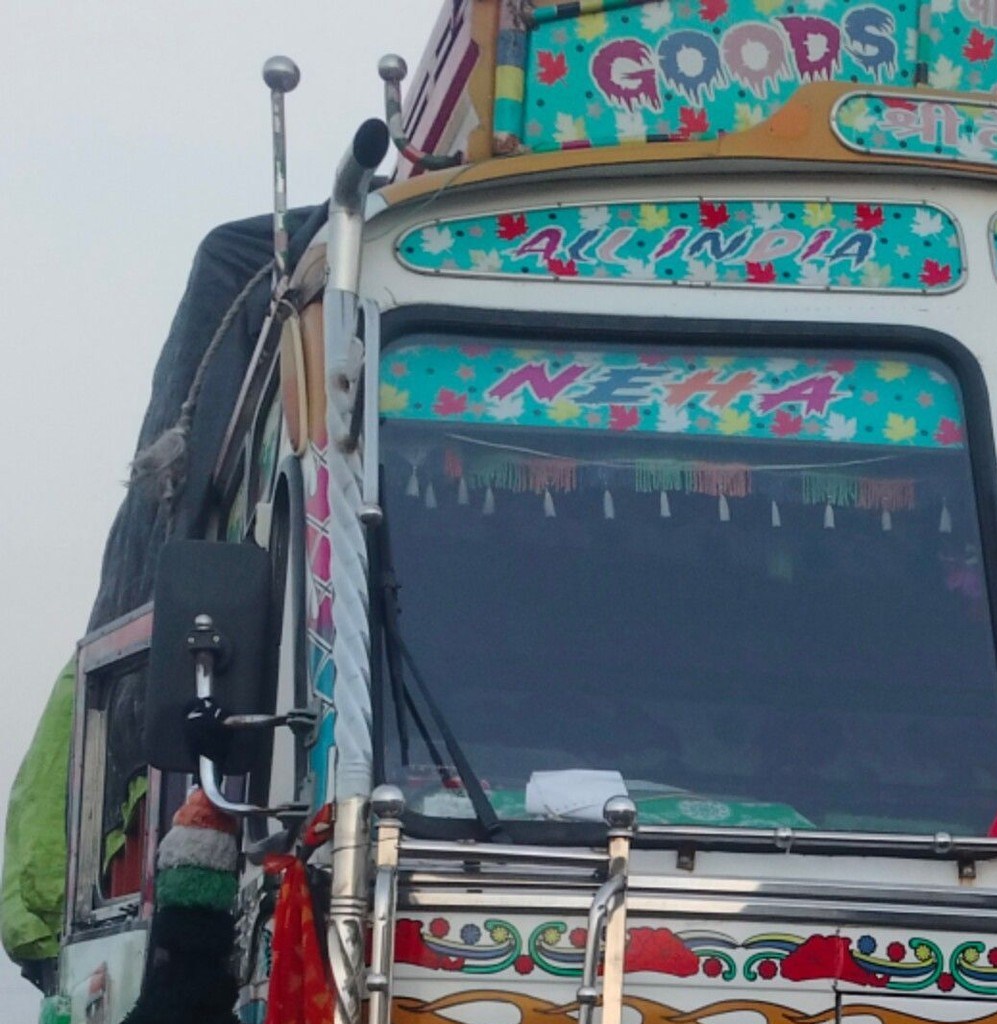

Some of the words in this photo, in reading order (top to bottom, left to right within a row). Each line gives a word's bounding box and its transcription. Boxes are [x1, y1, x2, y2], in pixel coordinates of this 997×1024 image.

[589, 5, 898, 114] GOODS
[877, 102, 962, 146] श्री
[509, 225, 636, 265] ALL
[652, 226, 877, 269] INDIA
[485, 360, 853, 418] NEHA
